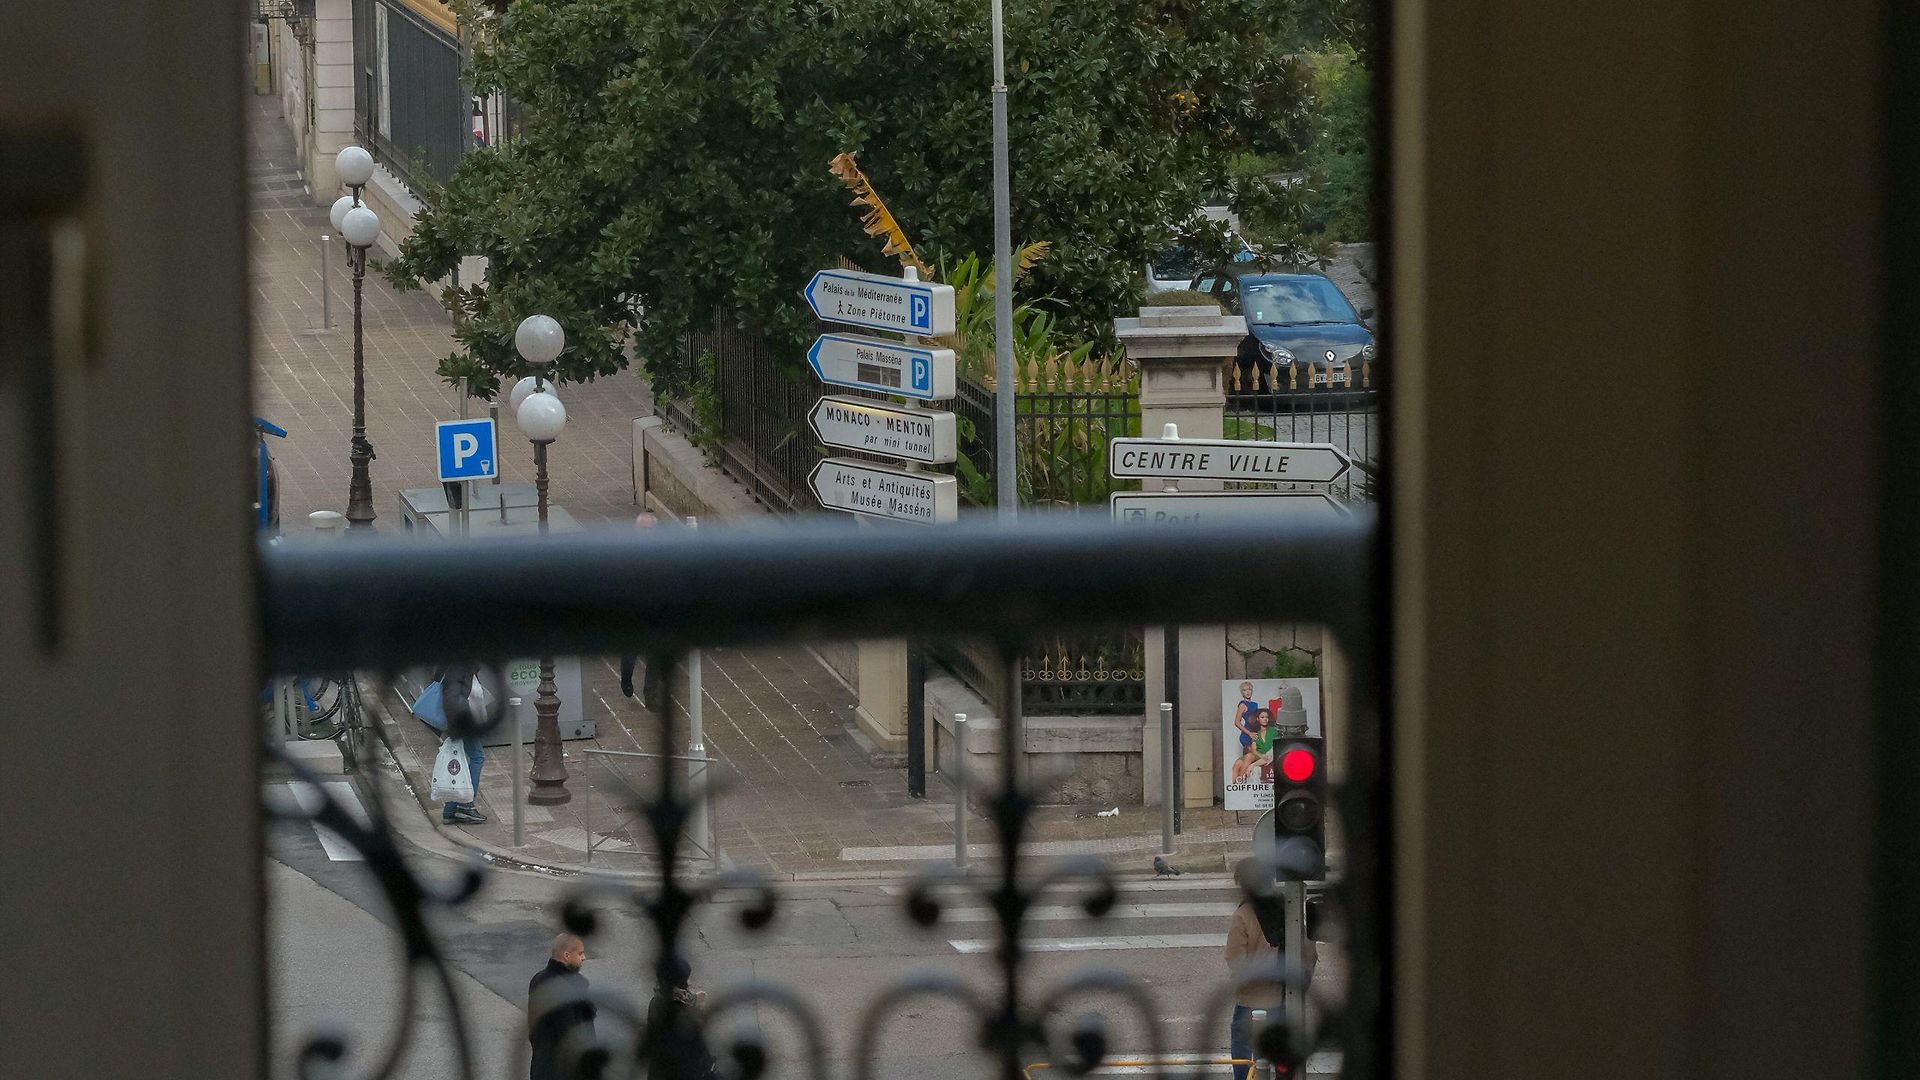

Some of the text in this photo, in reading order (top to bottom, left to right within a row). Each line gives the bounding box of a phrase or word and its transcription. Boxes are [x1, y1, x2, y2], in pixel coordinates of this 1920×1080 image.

[823, 282, 844, 295] Palais
[857, 287, 903, 304] Méditerranée
[847, 304, 906, 324] Zone Piétonne
[914, 298, 926, 325] P
[856, 348, 902, 366] Palais Masséna
[915, 361, 926, 386] P
[826, 407, 870, 427] MONACO
[886, 417, 931, 438] MENTON
[454, 433, 479, 469] P
[864, 434, 878, 446] par
[905, 440, 931, 454] tunnel
[1122, 451, 1290, 473] CENTRE VILLE
[835, 470, 931, 500] Arts et Antiquités
[850, 491, 931, 518] Musée Masséna
[1154, 511, 1200, 528] Port
[511, 668, 537, 680] éco
